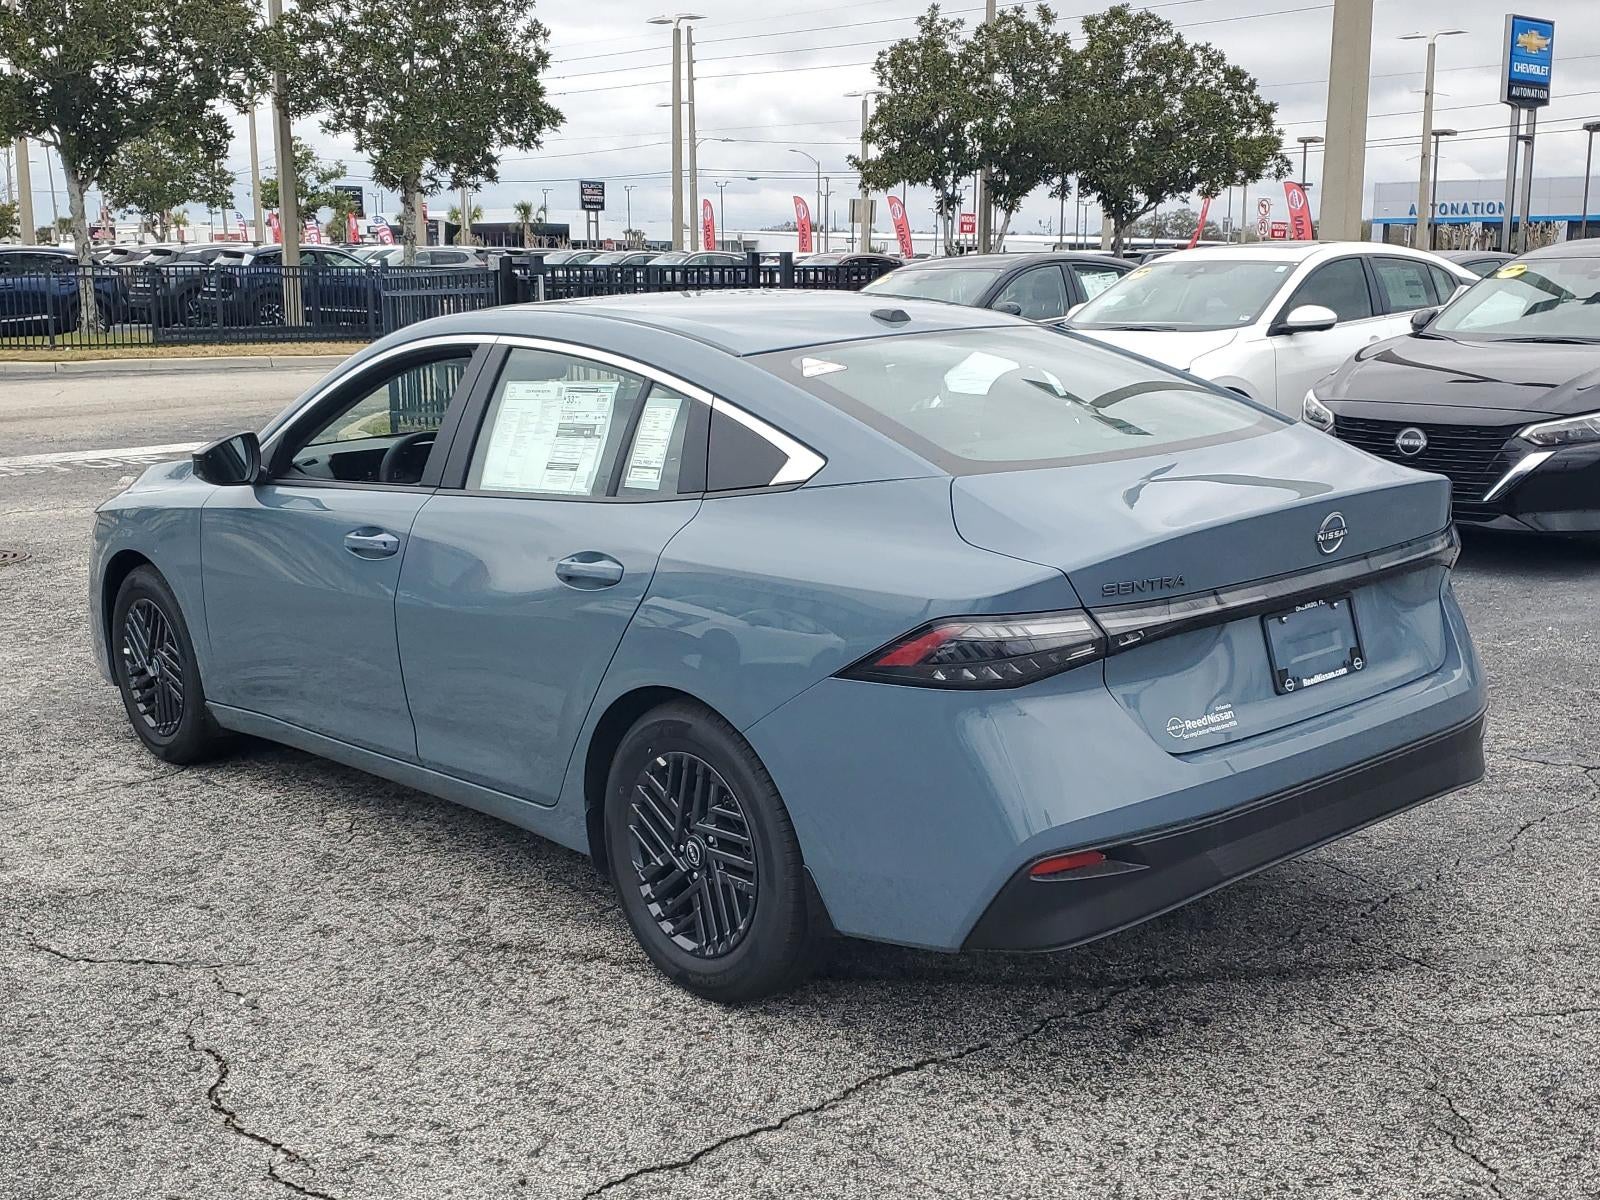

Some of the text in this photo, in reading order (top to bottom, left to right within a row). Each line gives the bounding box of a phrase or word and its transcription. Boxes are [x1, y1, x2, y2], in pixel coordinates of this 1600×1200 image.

[1513, 62, 1549, 76] CHEVROLET
[1511, 86, 1548, 99] AUTONATION
[1408, 202, 1505, 216] ATONATION
[1317, 528, 1348, 542] NISSAN
[1102, 574, 1185, 598] SENTRA
[1302, 667, 1348, 687] ReedNissan.com
